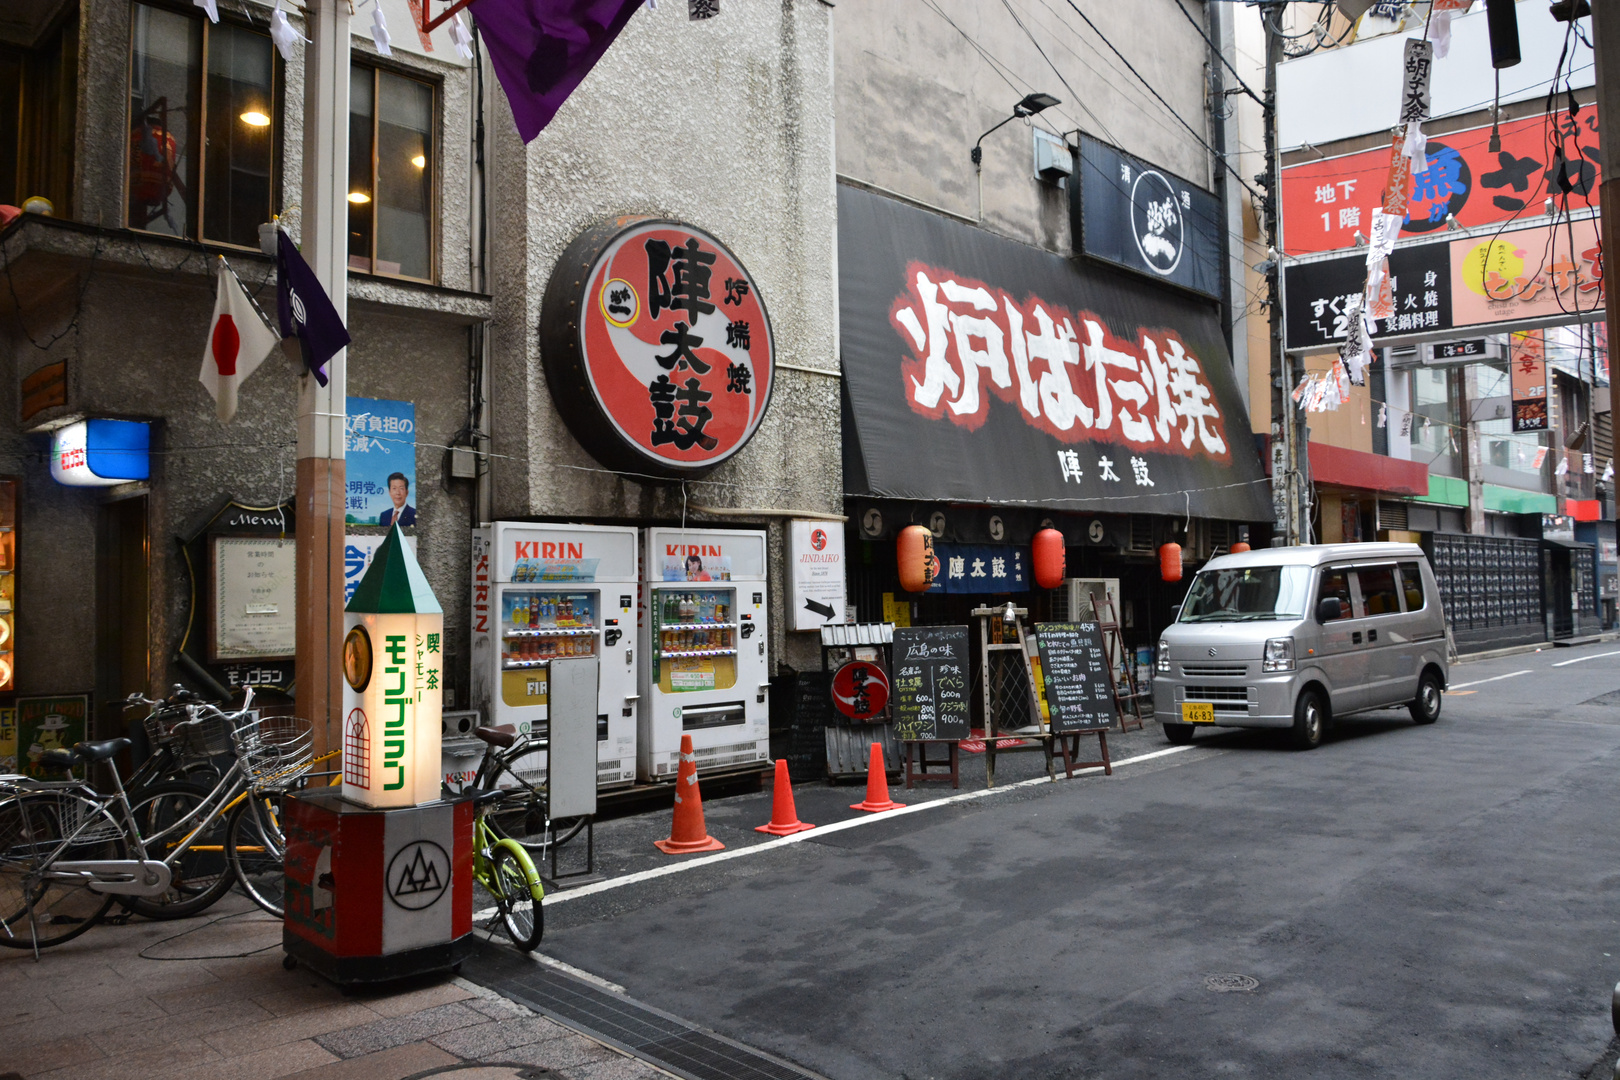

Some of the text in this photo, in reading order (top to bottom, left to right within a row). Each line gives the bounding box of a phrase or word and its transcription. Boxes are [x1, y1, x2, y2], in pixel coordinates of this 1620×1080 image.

[1402, 57, 1430, 123] 胡子大祭
[1384, 153, 1408, 215] 胡子大祭
[1406, 147, 1466, 202] 魚
[1315, 179, 1358, 204] 地下
[1321, 208, 1361, 232] 1階
[1495, 308, 1515, 317] utage
[645, 237, 718, 451] 陣太鼓
[724, 277, 752, 394] 炉端焼
[896, 271, 1226, 454] 炉ばた焼
[1528, 385, 1545, 397] 2F
[1057, 449, 1154, 486] 陣太鼓
[230, 514, 285, 526] Menu
[515, 541, 583, 560] KIRIN
[666, 544, 721, 557] KIRIN
[800, 554, 839, 563] JINDAIKO
[949, 555, 1007, 579] 陣太鼓
[476, 555, 488, 633] KIRIN
[426, 633, 440, 690] 喫茶
[905, 642, 954, 659] 広島の味
[415, 634, 424, 702] シャモニー
[940, 664, 961, 675] 珍味
[852, 667, 871, 714] 陣太鼓
[383, 635, 413, 791] モンブラン
[1189, 711, 1212, 720] 46-83
